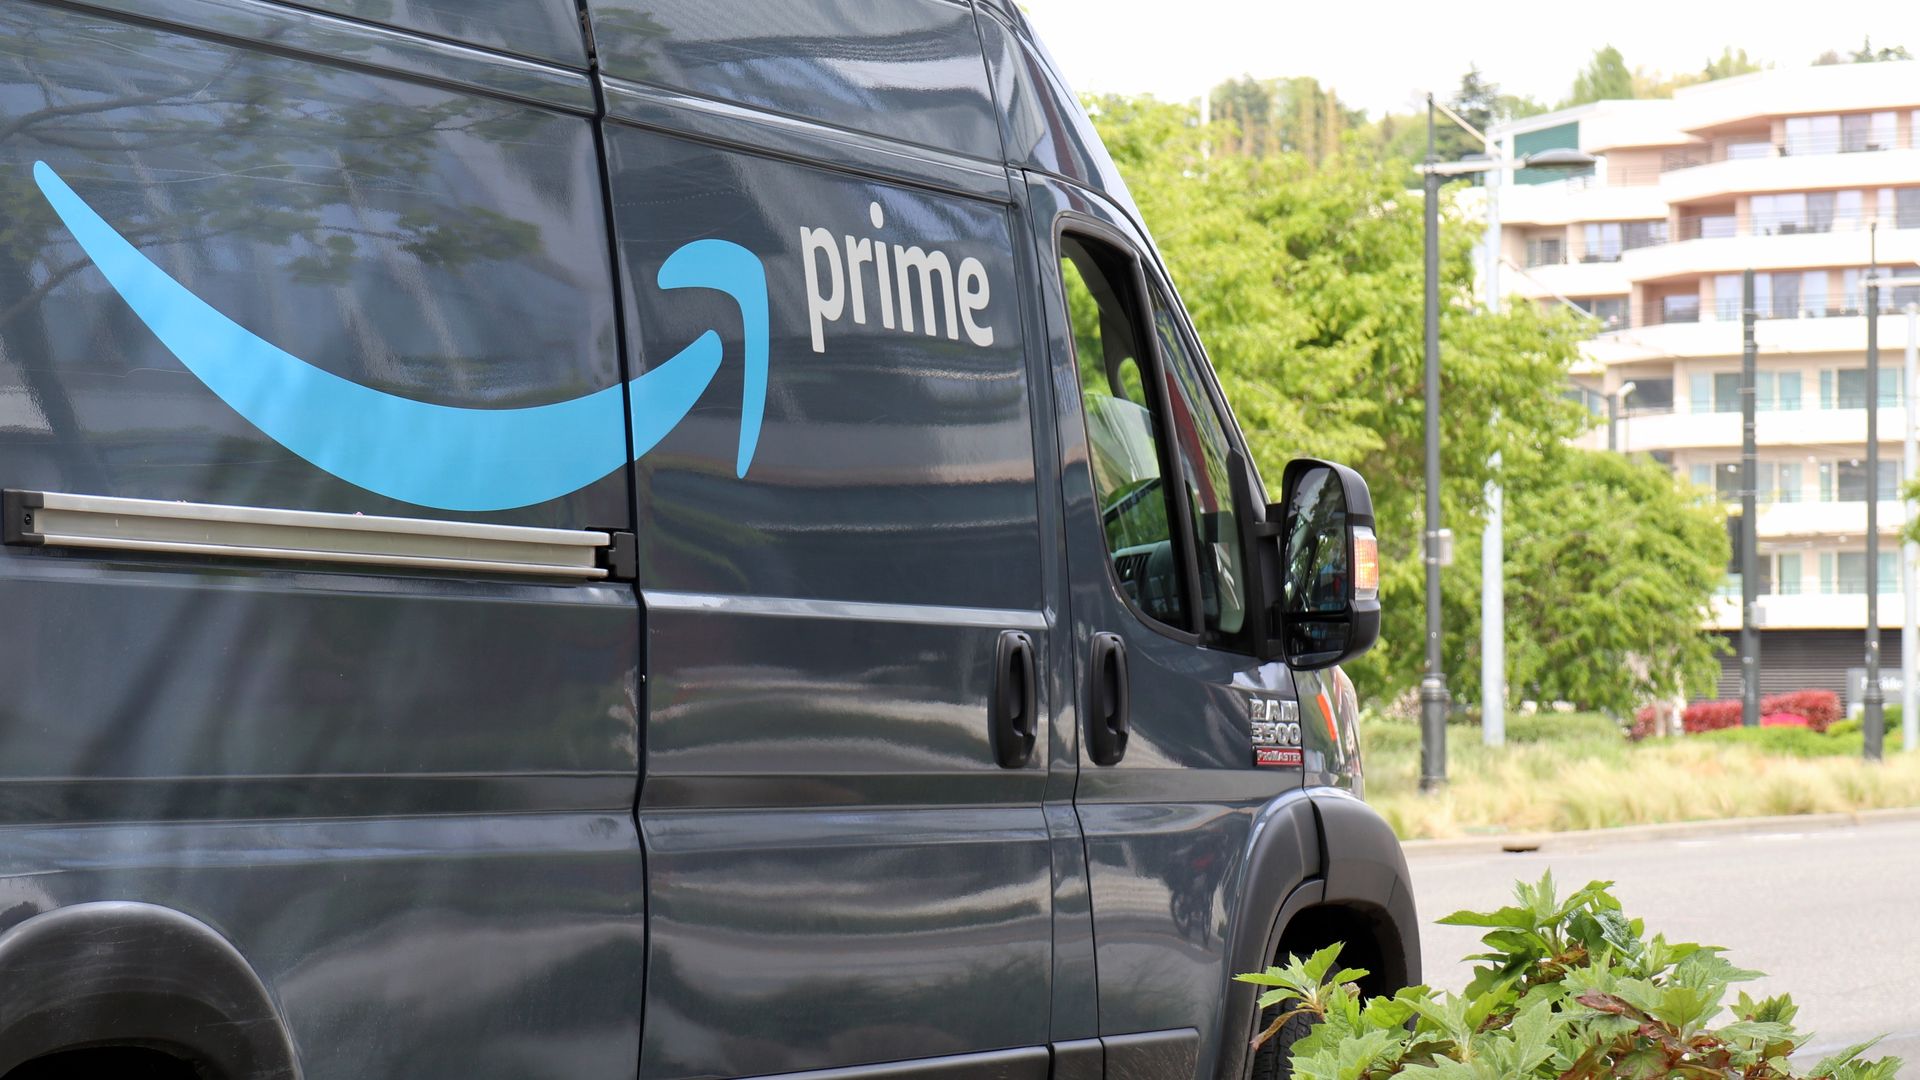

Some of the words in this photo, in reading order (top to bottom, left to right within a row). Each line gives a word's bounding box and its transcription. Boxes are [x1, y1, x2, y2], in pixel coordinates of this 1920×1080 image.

[800, 202, 994, 353] prime
[1249, 699, 1299, 721] RAM
[1250, 722, 1301, 745] 3500
